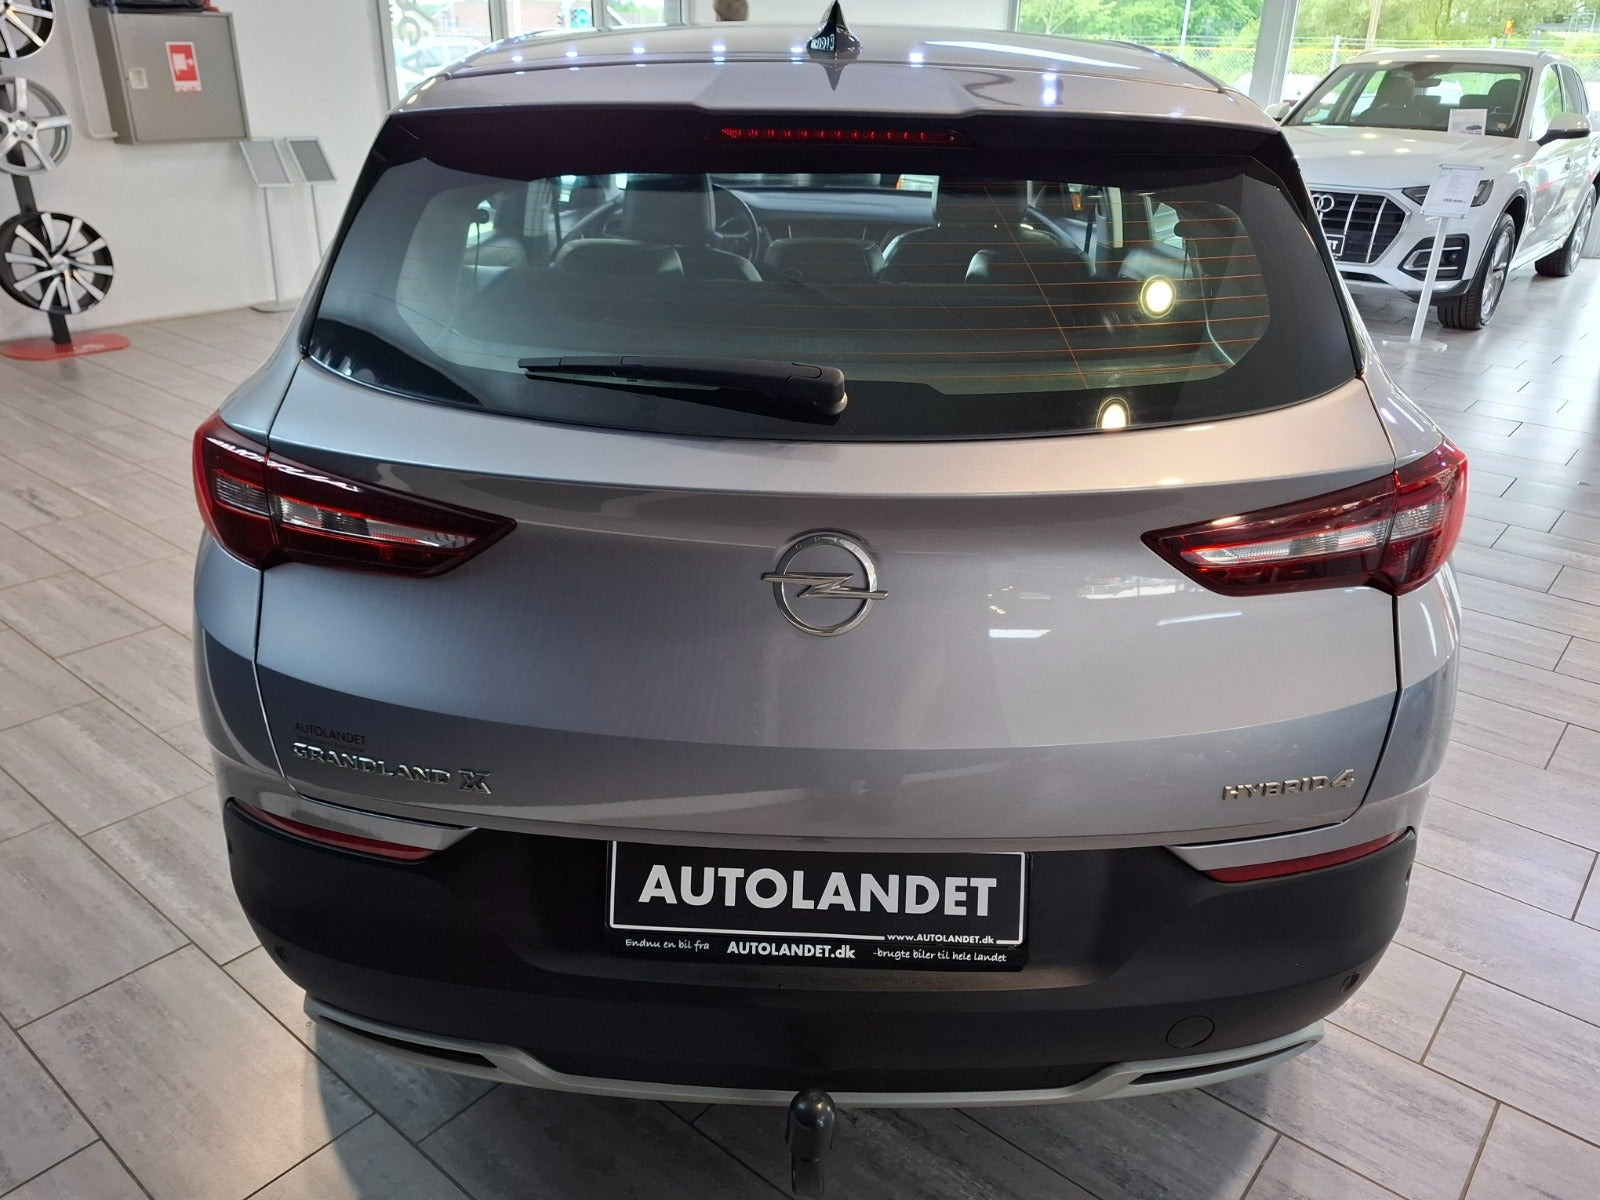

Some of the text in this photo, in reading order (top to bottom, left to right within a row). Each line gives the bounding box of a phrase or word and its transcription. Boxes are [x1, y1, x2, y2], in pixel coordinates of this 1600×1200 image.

[294, 721, 367, 745] AUTOLANDET
[292, 742, 451, 785] GRANDLAND
[457, 769, 492, 794] X
[638, 864, 997, 917] AUTOLANDET
[625, 938, 661, 948] Endnu
[663, 941, 677, 949] en
[678, 939, 692, 949] bil
[694, 940, 710, 952] fra
[726, 941, 857, 959] AUTOLANDET.dk
[913, 949, 936, 960] biler
[937, 950, 950, 960] til
[952, 950, 972, 961] hele
[974, 952, 1007, 962] landet
[887, 933, 995, 945] www.AUTOLANDET.dk
